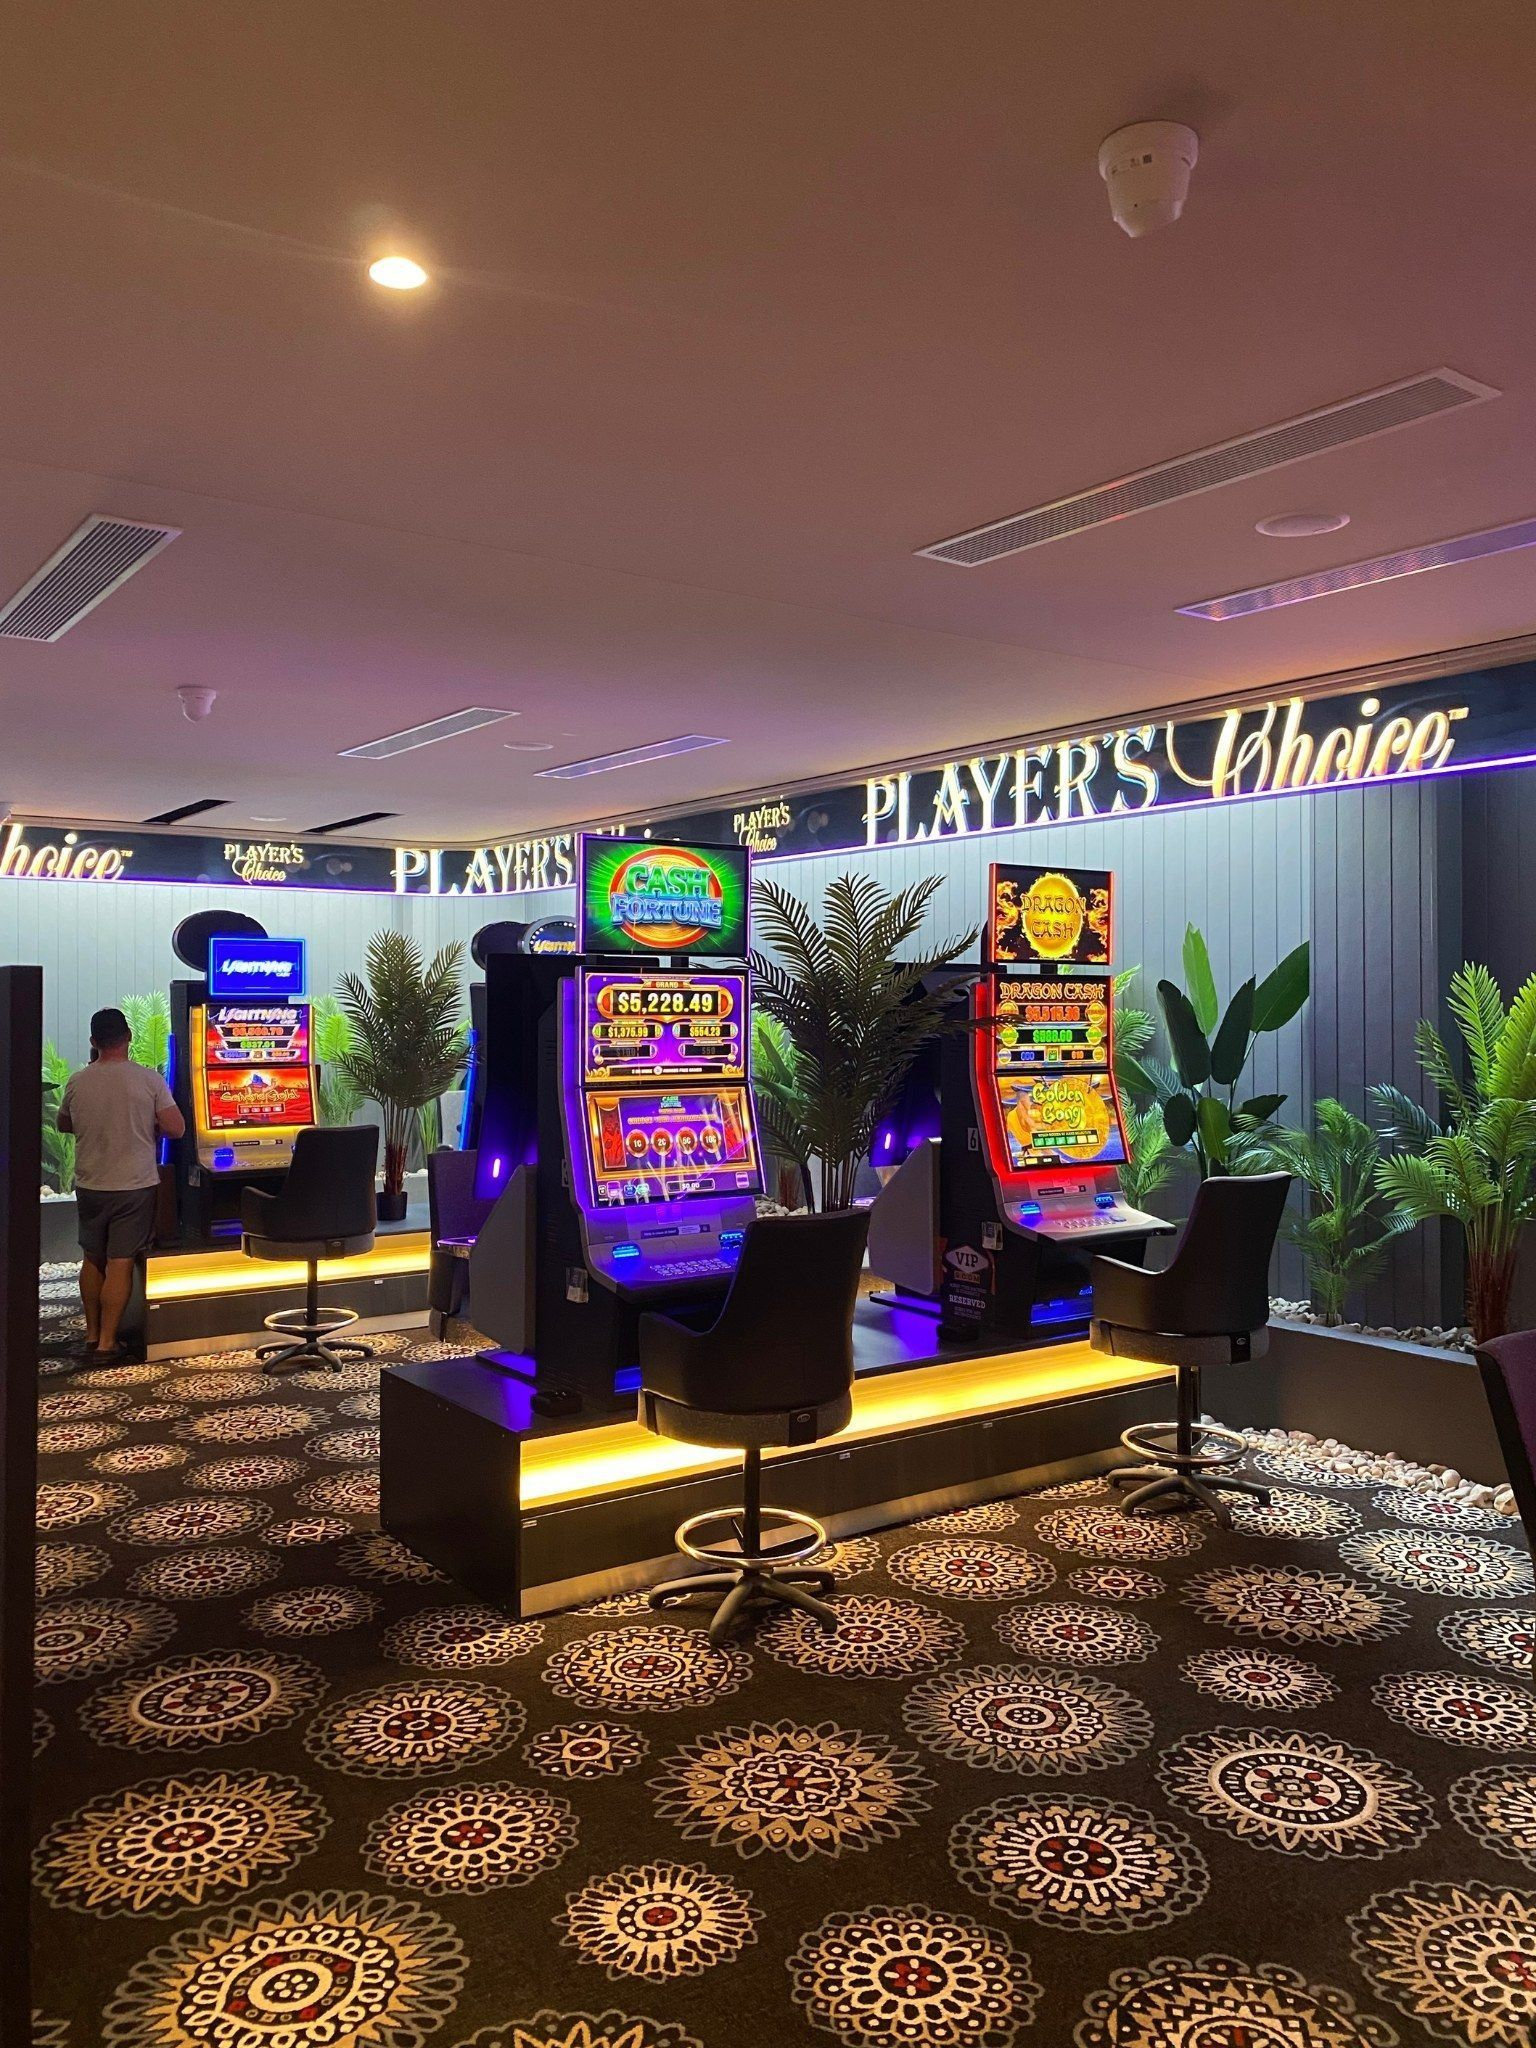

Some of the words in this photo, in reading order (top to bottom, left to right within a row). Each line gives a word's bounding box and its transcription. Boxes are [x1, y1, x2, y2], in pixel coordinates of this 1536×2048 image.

[862, 724, 1159, 846] PLAYER'S
[1166, 697, 1456, 797] Choice
[733, 802, 790, 833] PLAYER'S
[0, 823, 124, 880] hoice
[223, 842, 304, 864] PLAYER'S
[739, 828, 777, 853] Choice
[232, 857, 286, 884] Choice
[391, 833, 574, 895] PLAYER'S
[625, 864, 710, 899] CASH
[611, 893, 723, 930] FORTUNE
[1021, 894, 1087, 914] DRAGON
[1031, 921, 1075, 939] CASH
[618, 991, 713, 1014] $5,228.49
[1000, 982, 1063, 1000] DRAGON
[1064, 983, 1105, 1000] CASH
[1032, 1081, 1085, 1106] Golden
[1042, 1103, 1083, 1128] Gong
[971, 1130, 977, 1147] 6
[955, 1251, 978, 1268] VIP
[949, 1294, 986, 1309] RESERVED
